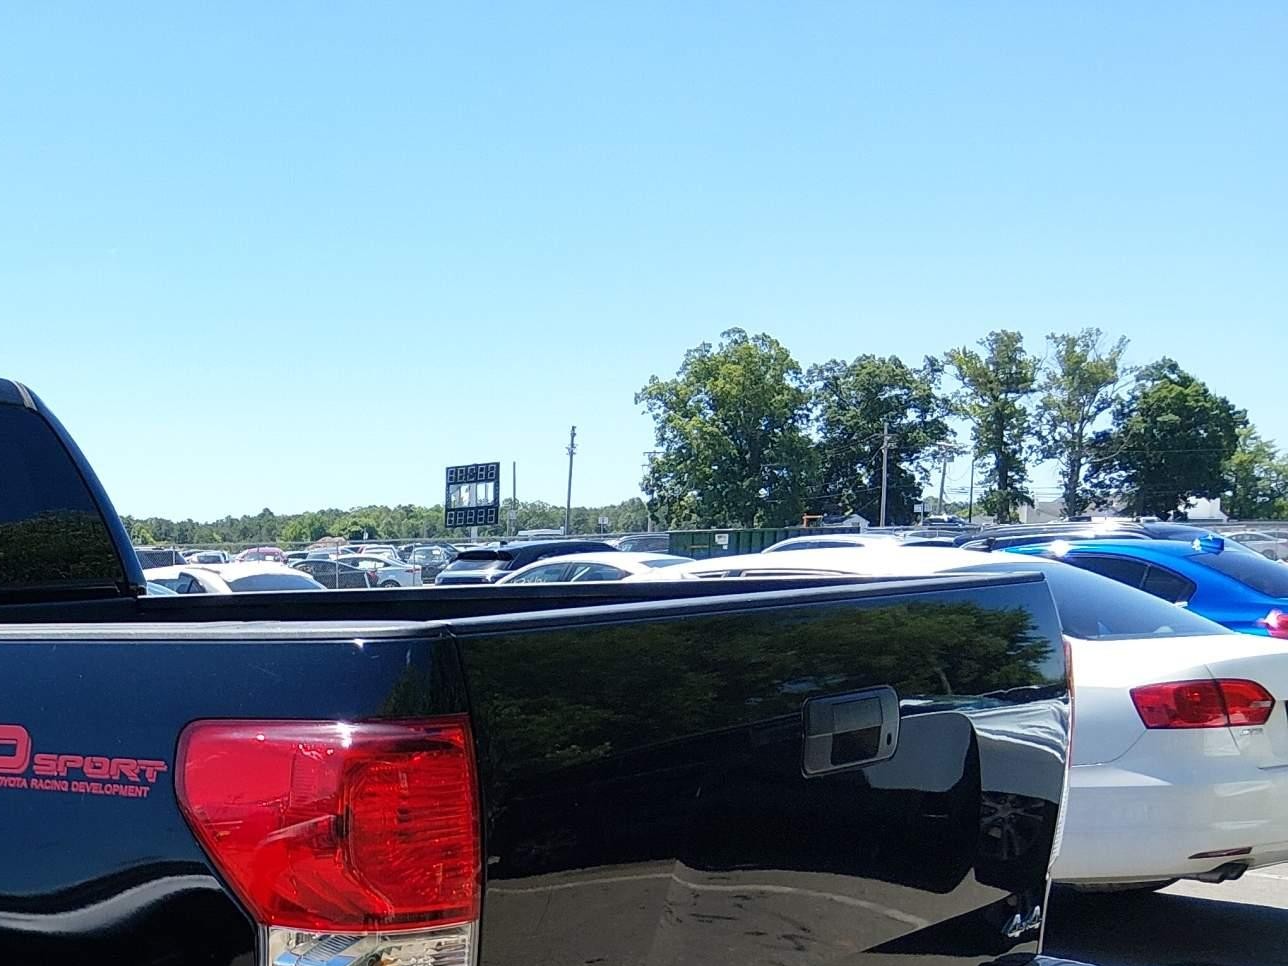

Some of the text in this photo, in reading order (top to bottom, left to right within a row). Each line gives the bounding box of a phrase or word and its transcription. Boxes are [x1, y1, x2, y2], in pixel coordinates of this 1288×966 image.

[33, 753, 168, 783] SPORT
[30, 778, 69, 792] RACING
[71, 780, 150, 798] DEVELOPMENT
